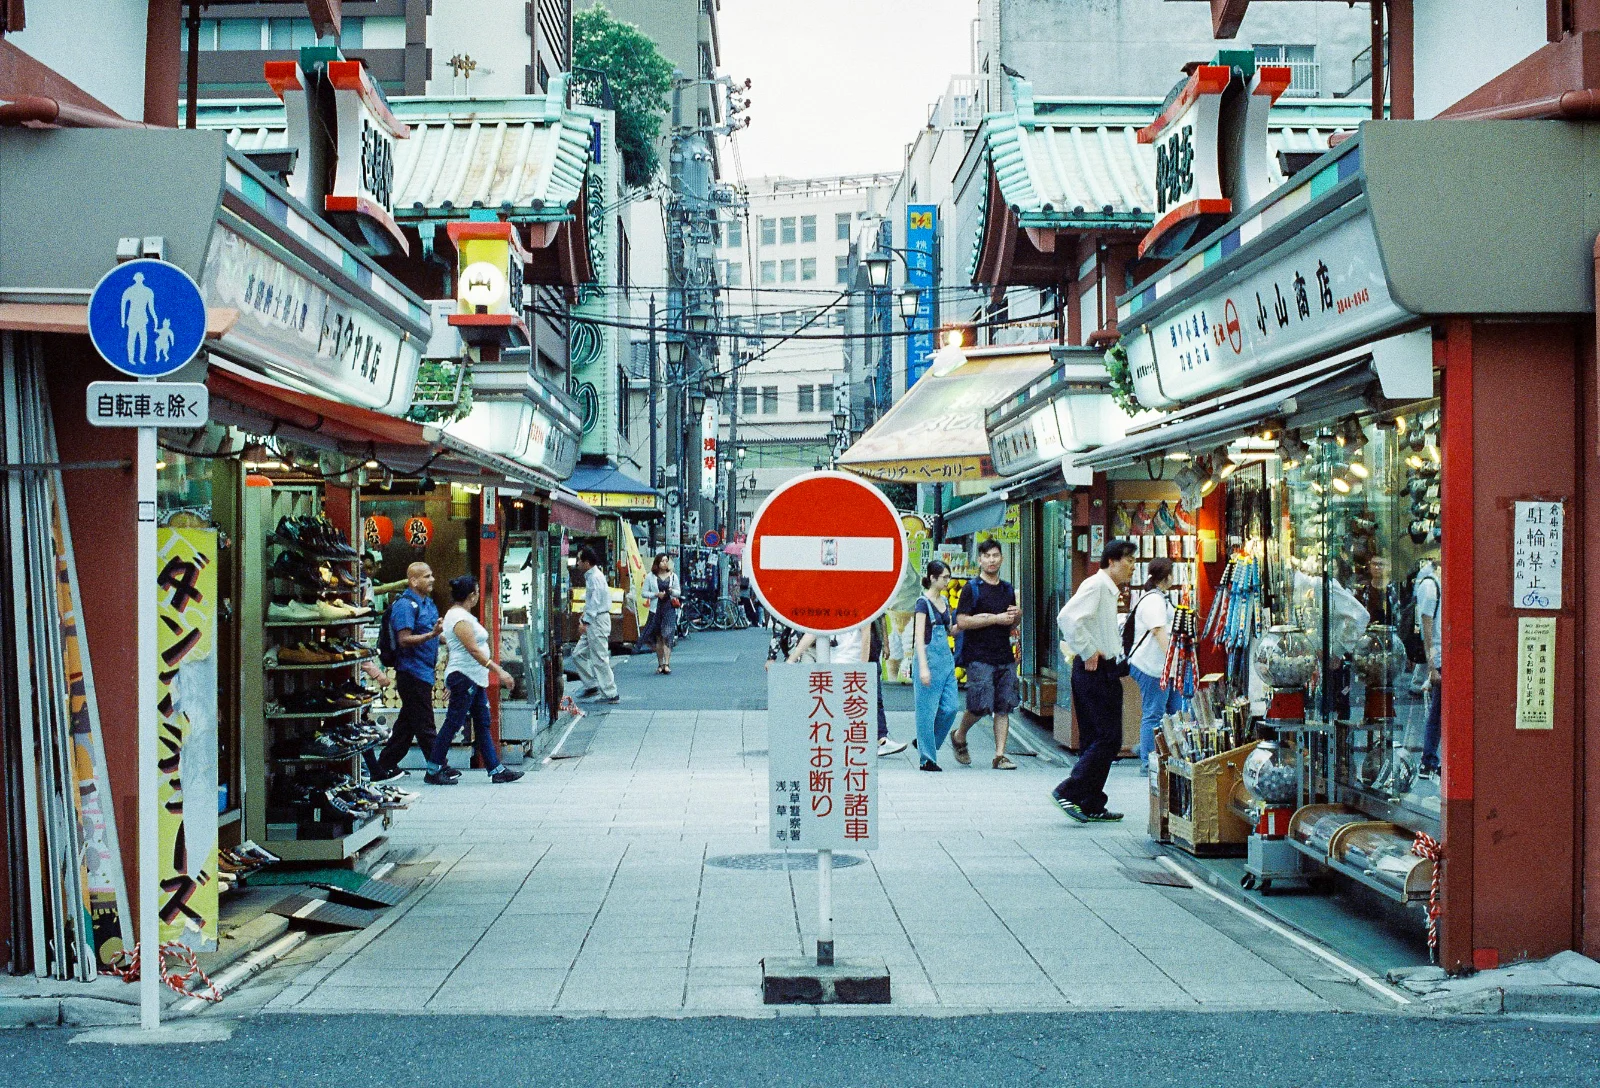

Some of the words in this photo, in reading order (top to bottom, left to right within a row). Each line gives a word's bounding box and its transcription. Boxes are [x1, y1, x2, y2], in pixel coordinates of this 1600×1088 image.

[1256, 259, 1333, 336] 小山商店
[98, 393, 200, 419] 自転車を除く
[1526, 507, 1546, 589] 駐輪禁止
[808, 671, 834, 818] 乗入れお断り
[842, 671, 869, 842] 表参道に付諸車
[789, 780, 801, 841] 浅草警察署
